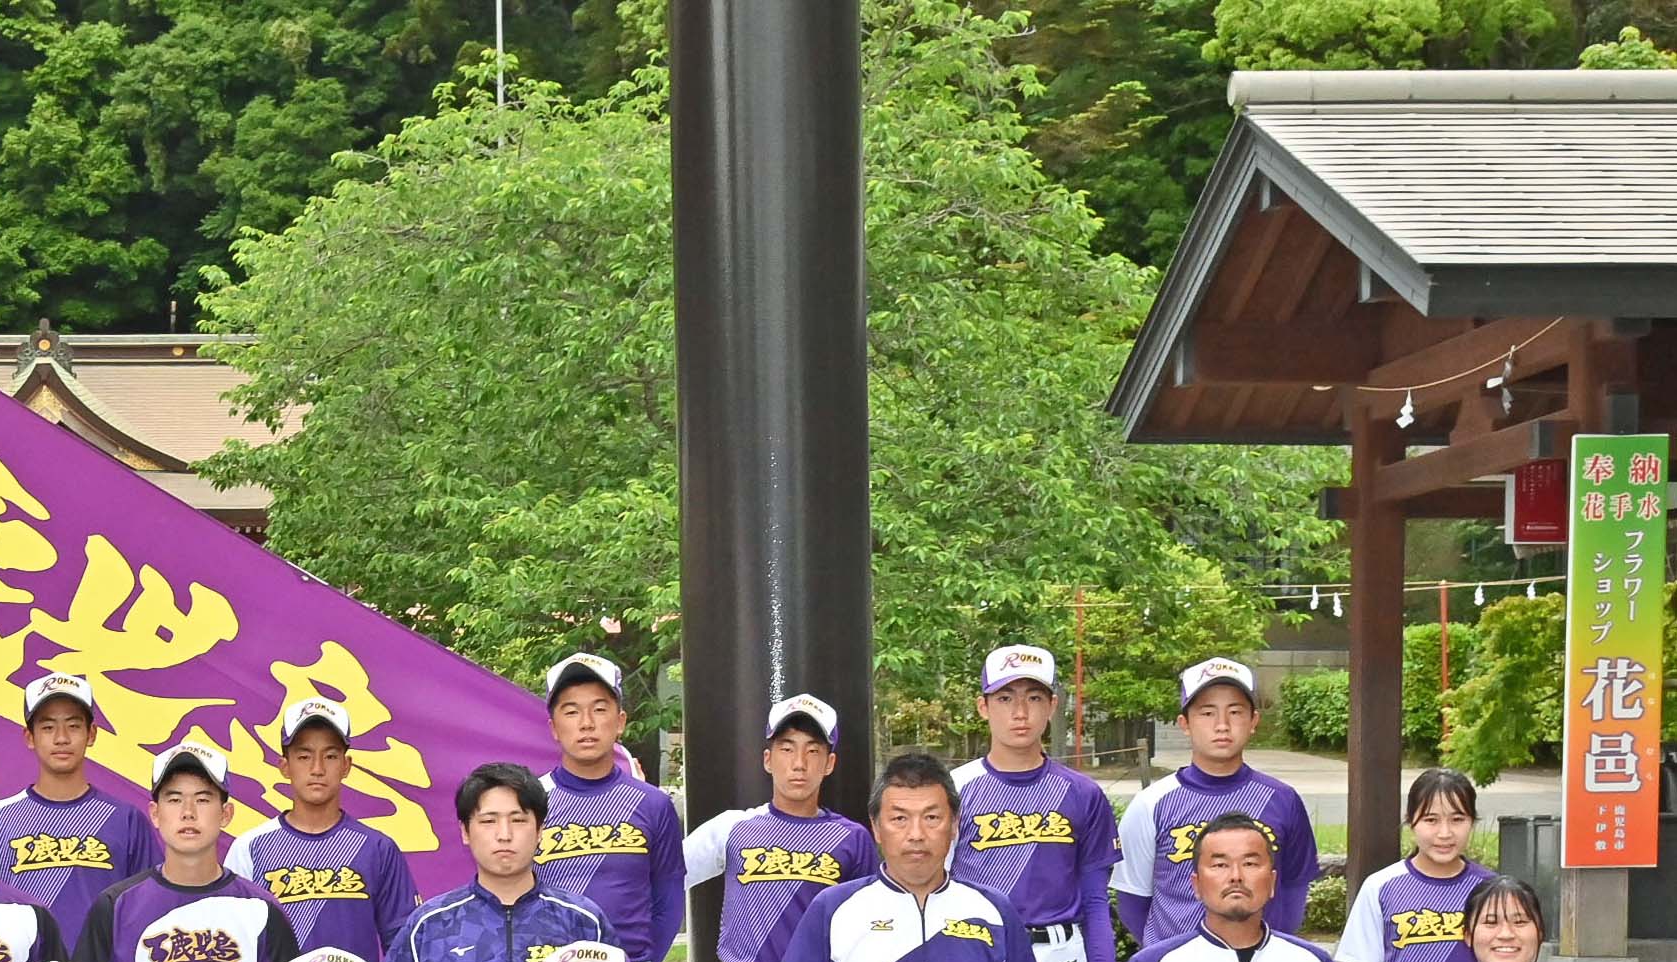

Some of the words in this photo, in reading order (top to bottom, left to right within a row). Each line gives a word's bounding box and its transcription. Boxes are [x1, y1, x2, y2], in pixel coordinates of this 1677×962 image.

[1582, 492, 1661, 521] 花手水
[1624, 531, 1645, 621] フラワー
[1591, 552, 1614, 645] ショップ
[1000, 652, 1042, 671] ROKKO
[1581, 657, 1646, 793] 花邑
[533, 823, 648, 865] 工鹿児島
[971, 810, 1075, 852] 工鹿児島
[9, 832, 114, 876] 工鹿児島
[737, 847, 842, 886] 工鹿児島
[264, 866, 370, 904] 工鹿児島
